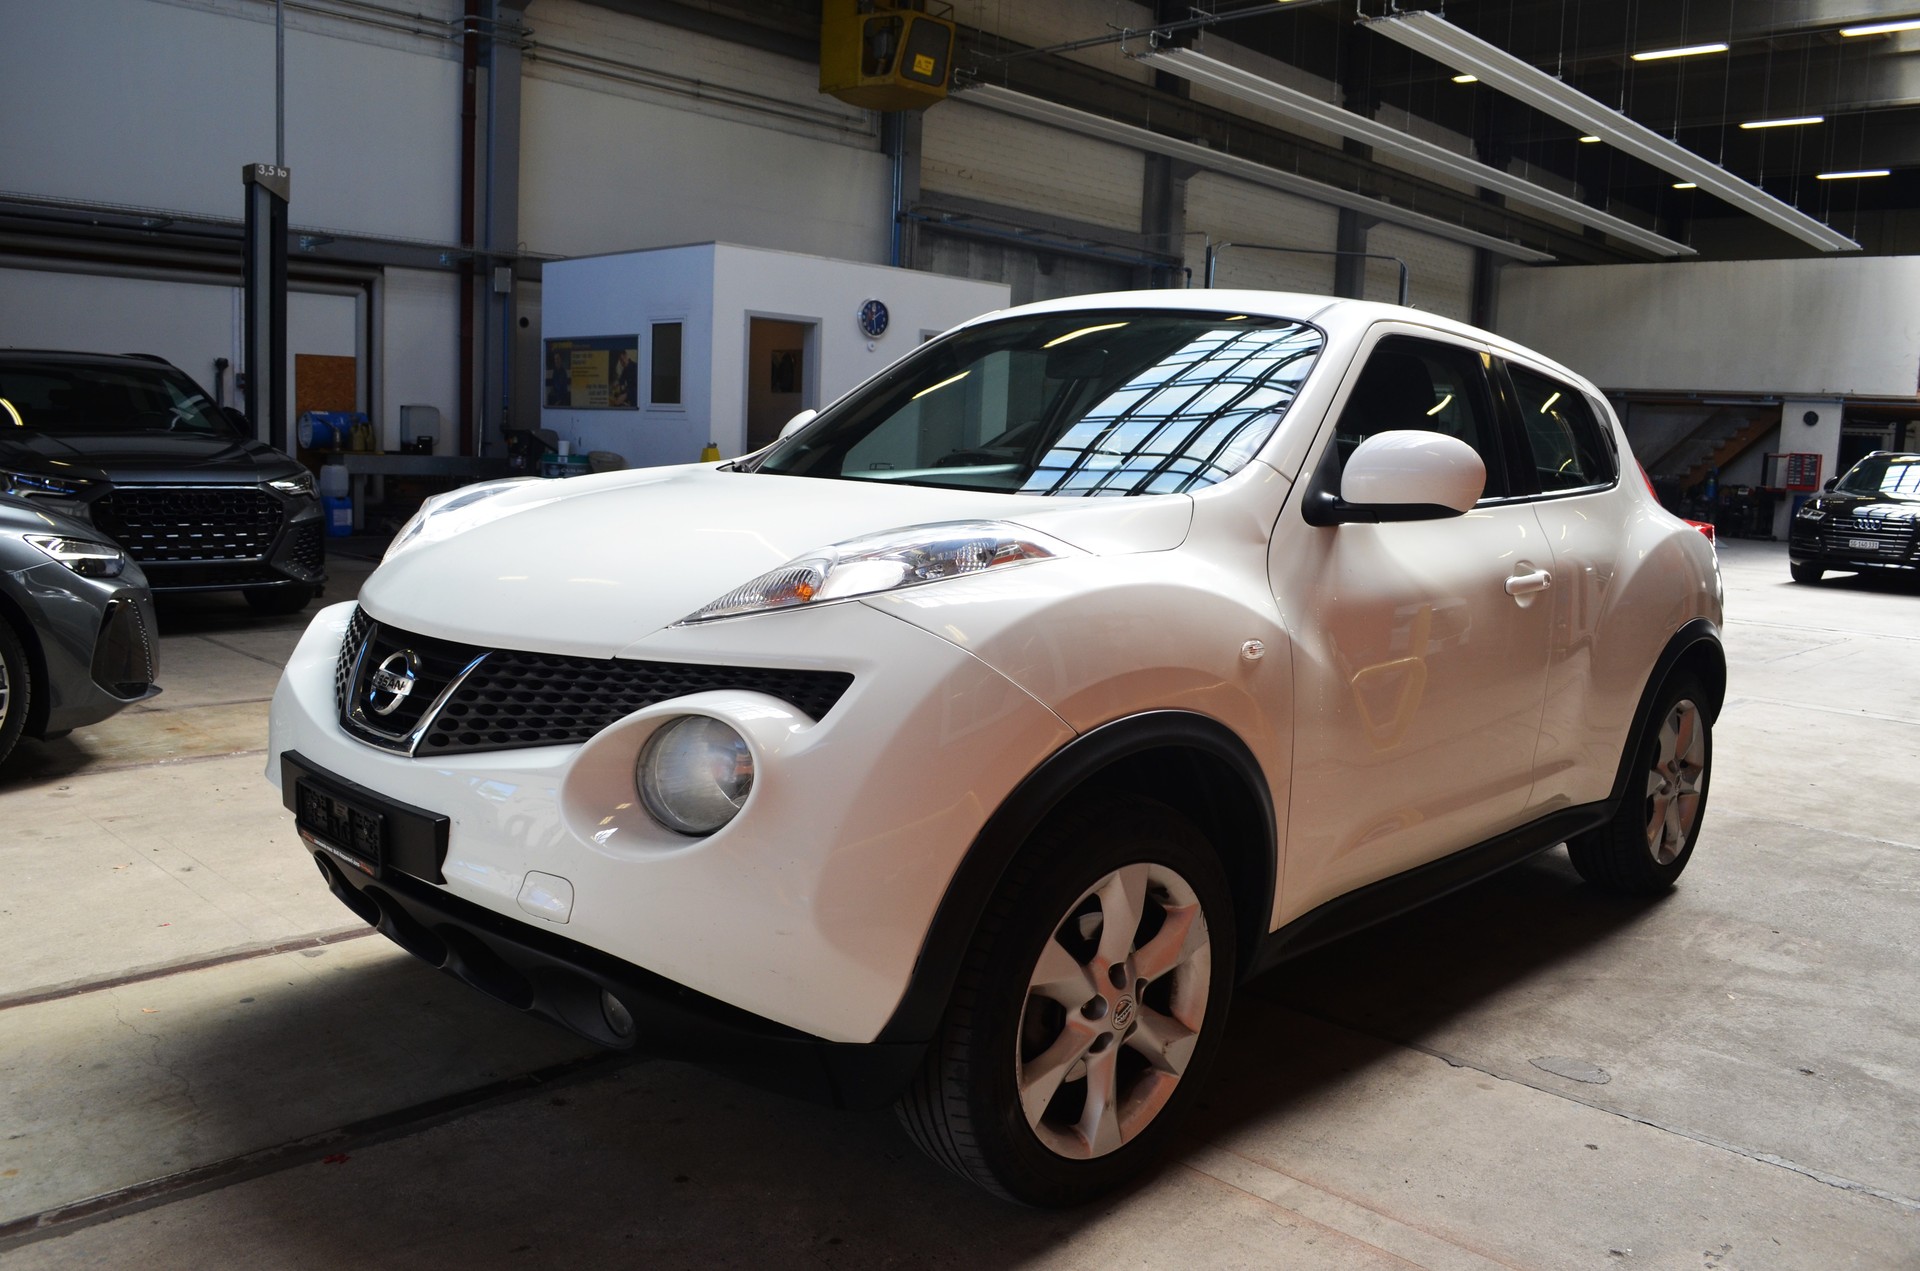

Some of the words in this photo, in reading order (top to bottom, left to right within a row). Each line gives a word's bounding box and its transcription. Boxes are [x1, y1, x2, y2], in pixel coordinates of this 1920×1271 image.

[258, 164, 275, 177] 3,5
[277, 167, 287, 178] to
[372, 671, 405, 690] SSAN
